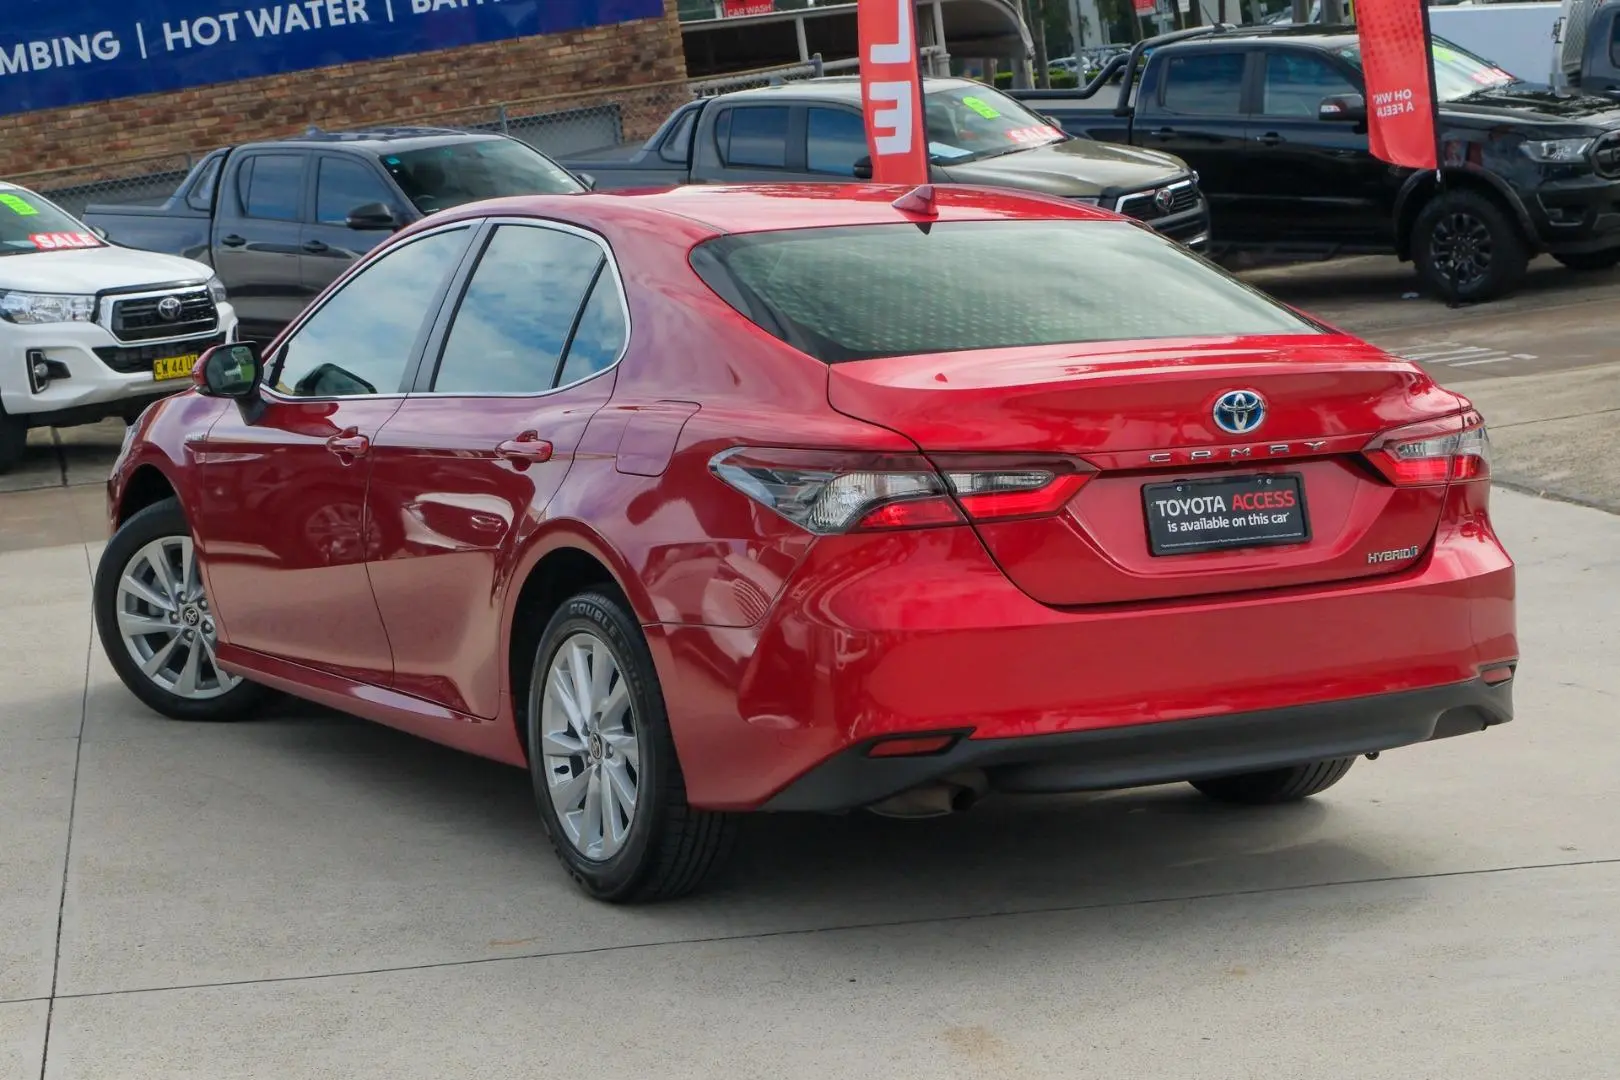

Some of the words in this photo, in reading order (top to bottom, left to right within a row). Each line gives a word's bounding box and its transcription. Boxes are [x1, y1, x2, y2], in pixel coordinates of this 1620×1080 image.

[0, 31, 120, 76] MBING
[162, 12, 239, 51] HOT
[244, 0, 370, 38] WATER
[35, 232, 100, 249] SALE
[1150, 440, 1326, 462] CAMRY
[1156, 495, 1227, 517] TOYOTA
[1231, 489, 1296, 512] ACCESS
[1167, 520, 1178, 533] is
[1180, 515, 1230, 532] available
[1232, 517, 1246, 527] on
[1248, 513, 1270, 525] this
[1367, 548, 1411, 564] HYBRID
[569, 602, 618, 638] DOUBLE
